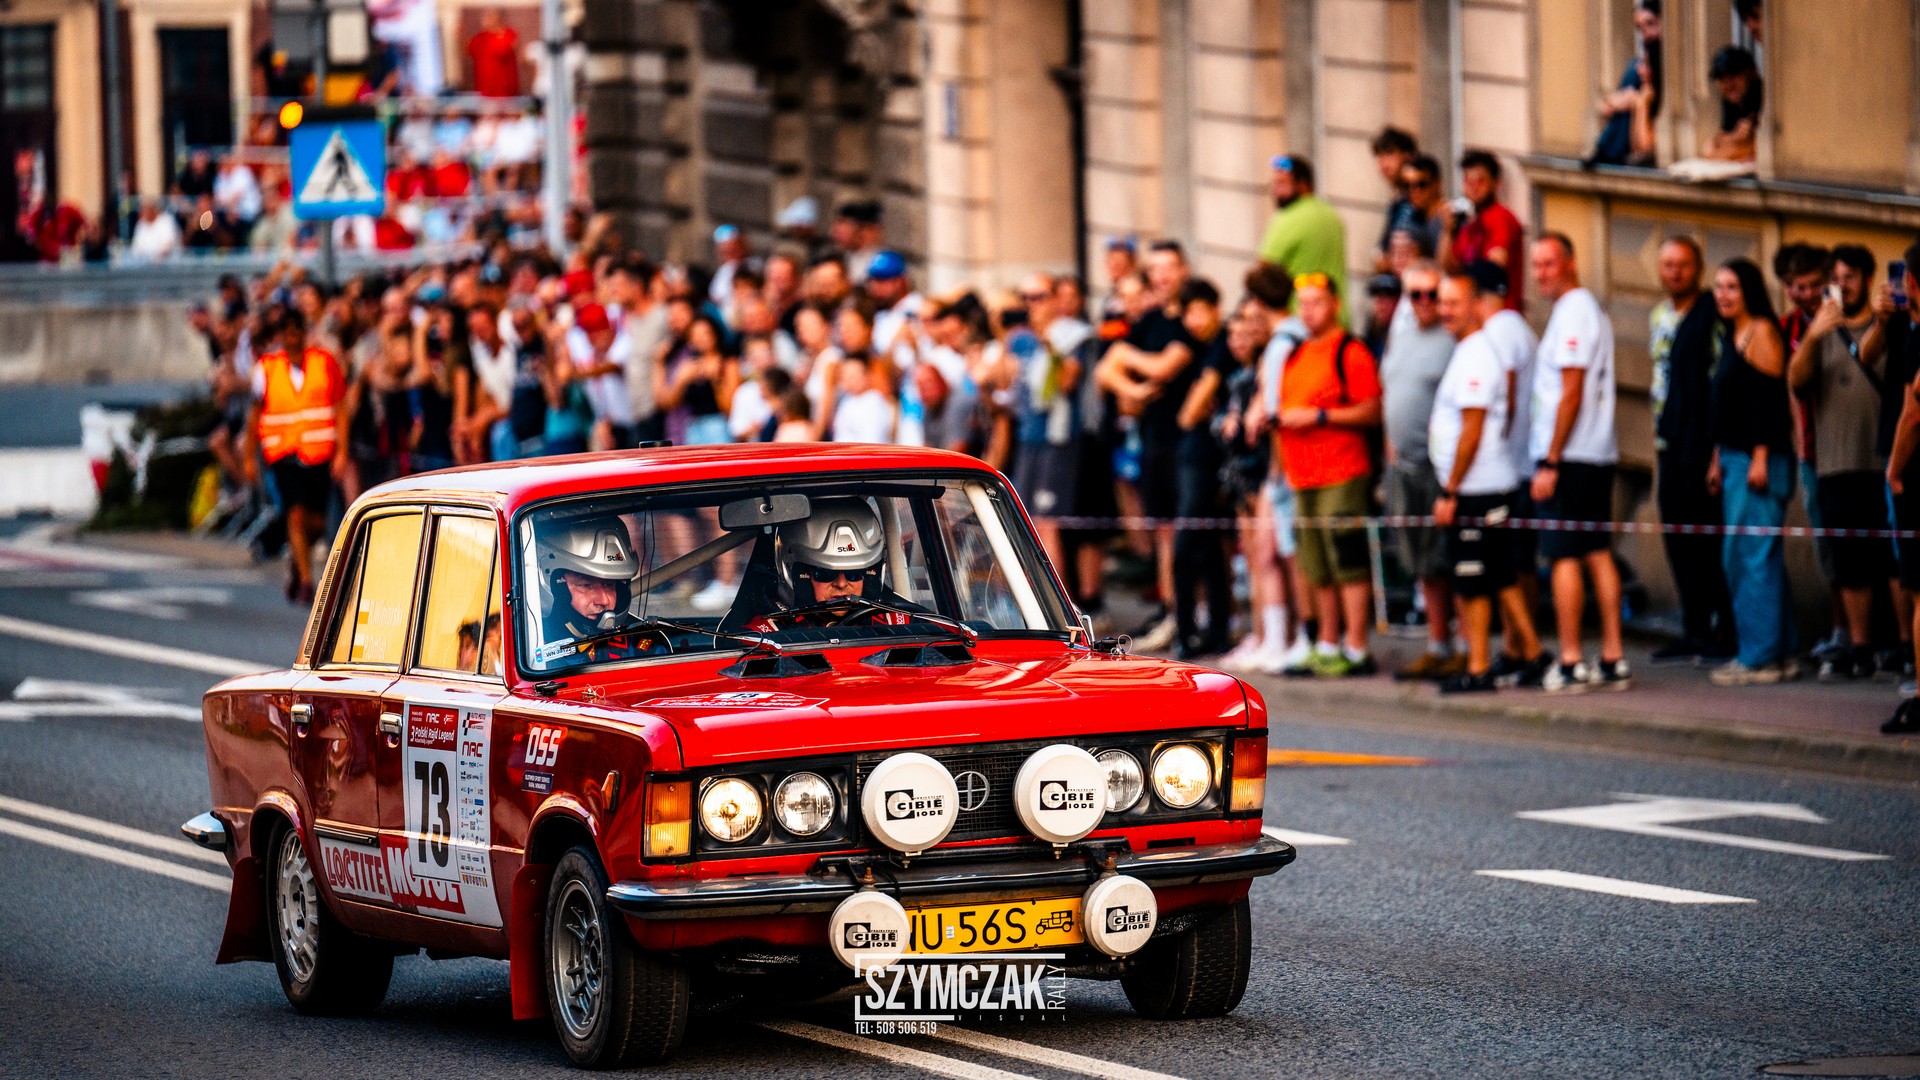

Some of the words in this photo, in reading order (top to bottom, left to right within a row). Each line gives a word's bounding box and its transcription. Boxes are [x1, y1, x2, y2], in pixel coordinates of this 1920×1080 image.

[837, 544, 856, 552] Stilo
[414, 726, 429, 739] Polski
[438, 729, 455, 743] Legend
[414, 760, 451, 868] 73
[916, 809, 944, 817] IODE
[325, 846, 387, 896] LOCTITE
[959, 907, 1027, 948] 56S
[1128, 923, 1150, 931] IODE
